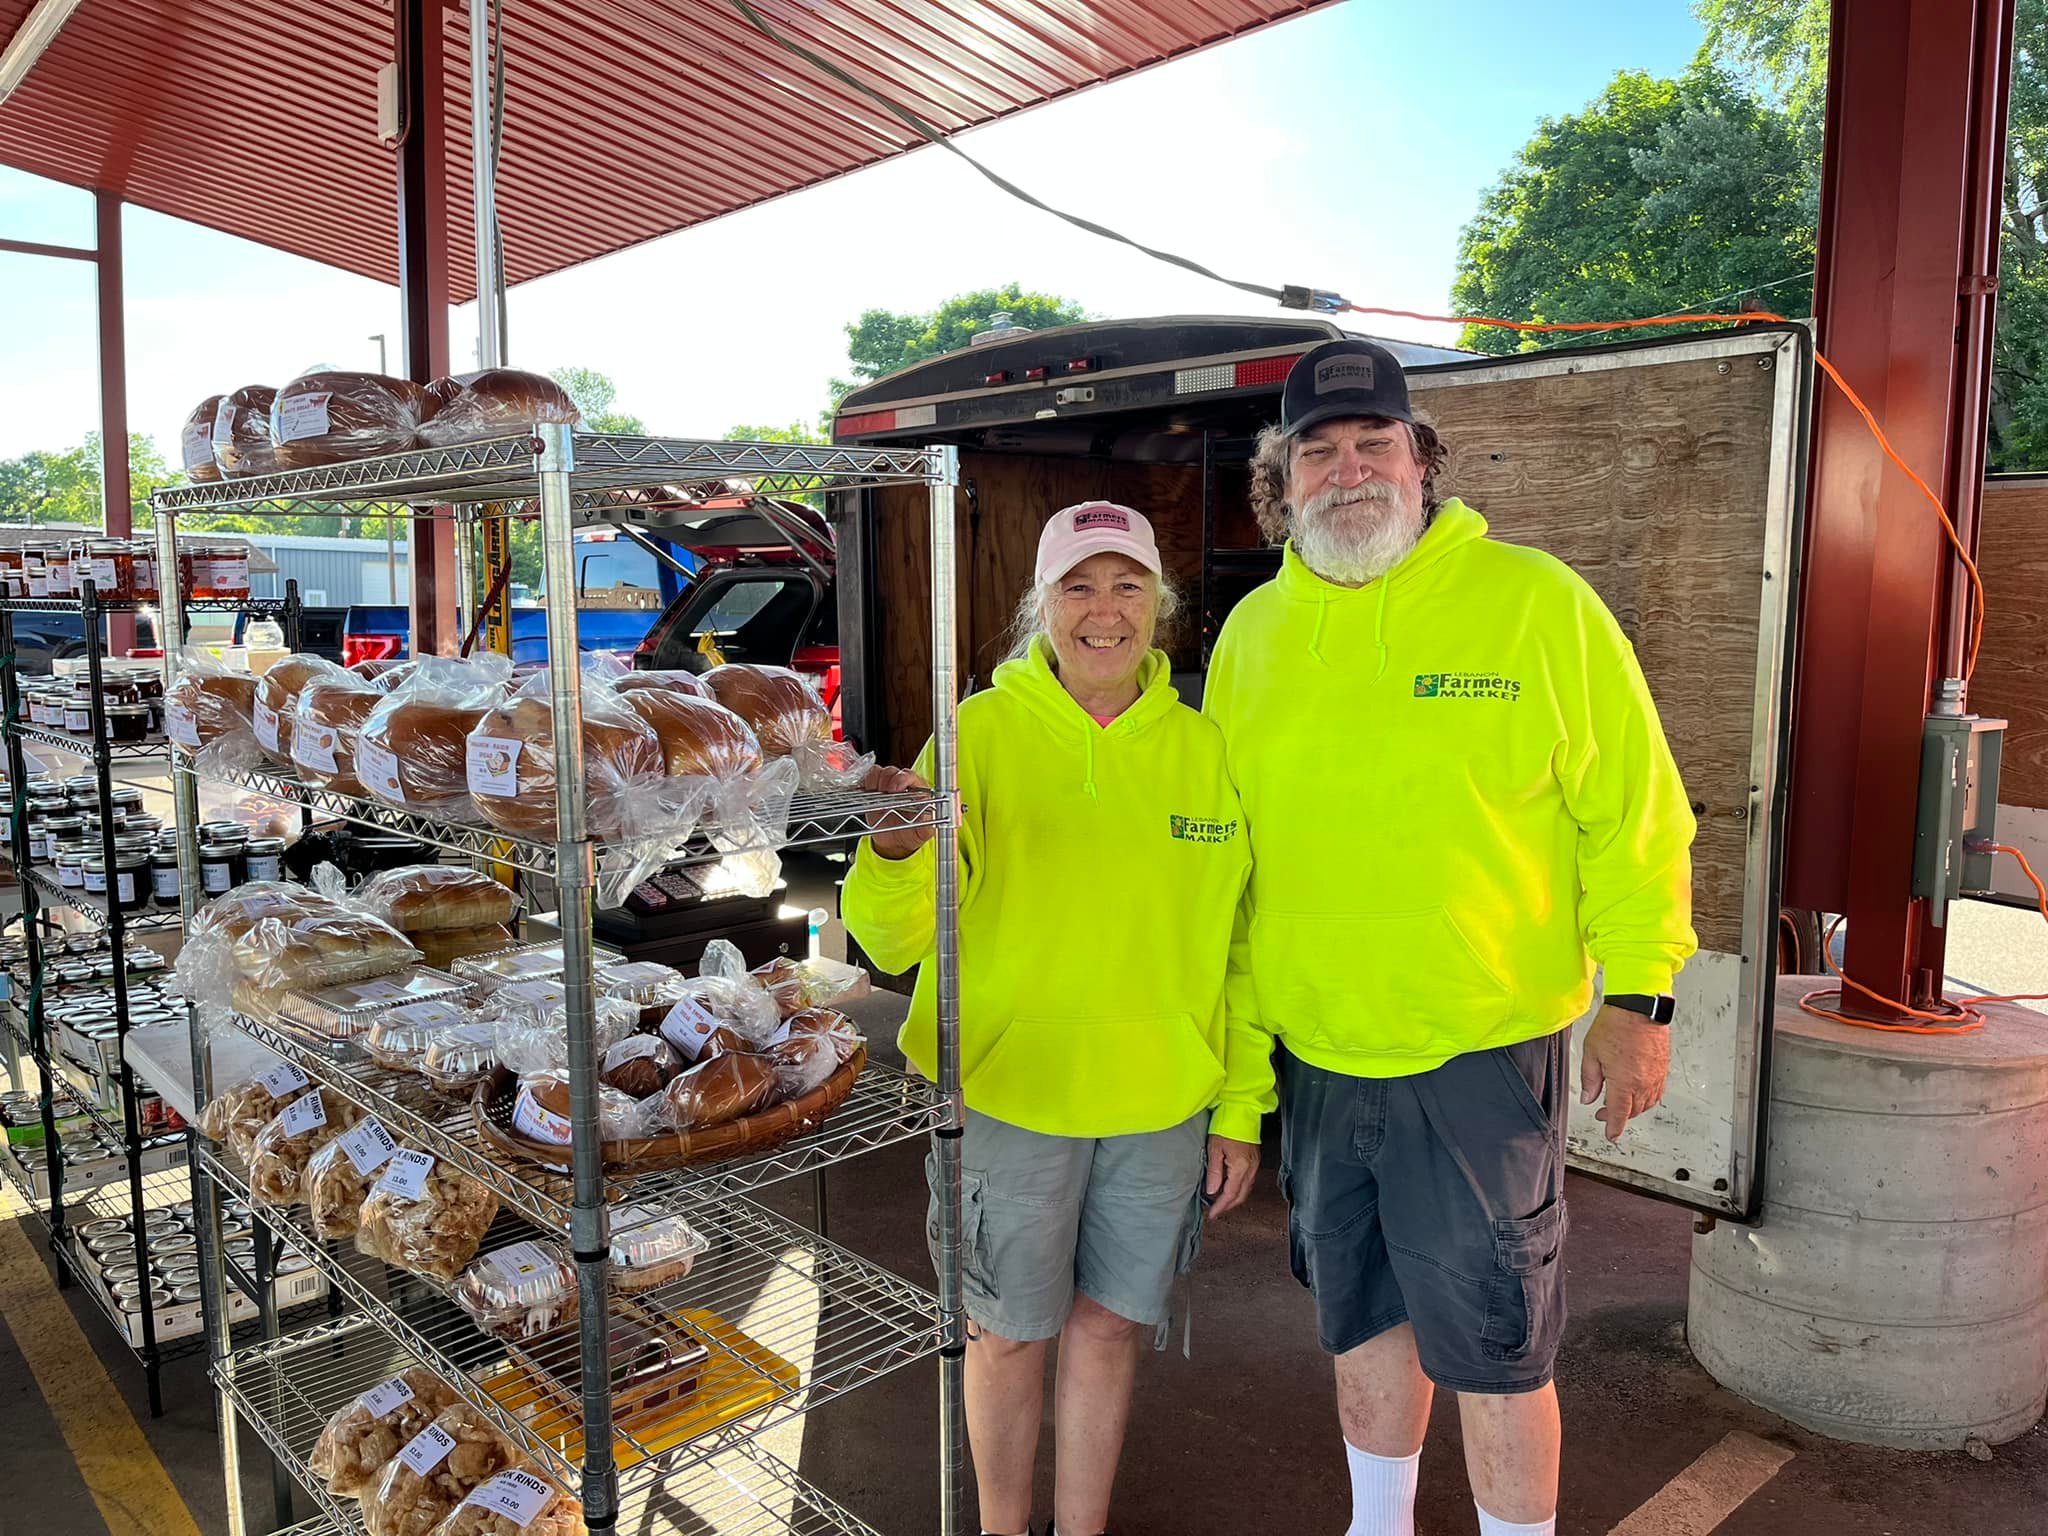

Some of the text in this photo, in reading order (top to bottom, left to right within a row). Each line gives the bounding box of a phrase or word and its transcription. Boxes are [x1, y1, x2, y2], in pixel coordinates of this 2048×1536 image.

[1439, 673, 1521, 692] Farmers
[1439, 690, 1521, 702] MARKET
[1184, 817, 1237, 835] Farmers
[1185, 829, 1237, 843] MARKET
[309, 1096, 323, 1120] RINDS
[372, 1126, 395, 1152] RINDS
[402, 1151, 429, 1166] RINDS
[427, 1426, 450, 1447] RINDS
[513, 1473, 547, 1495] RINDS
[499, 1496, 520, 1510] $3.00
